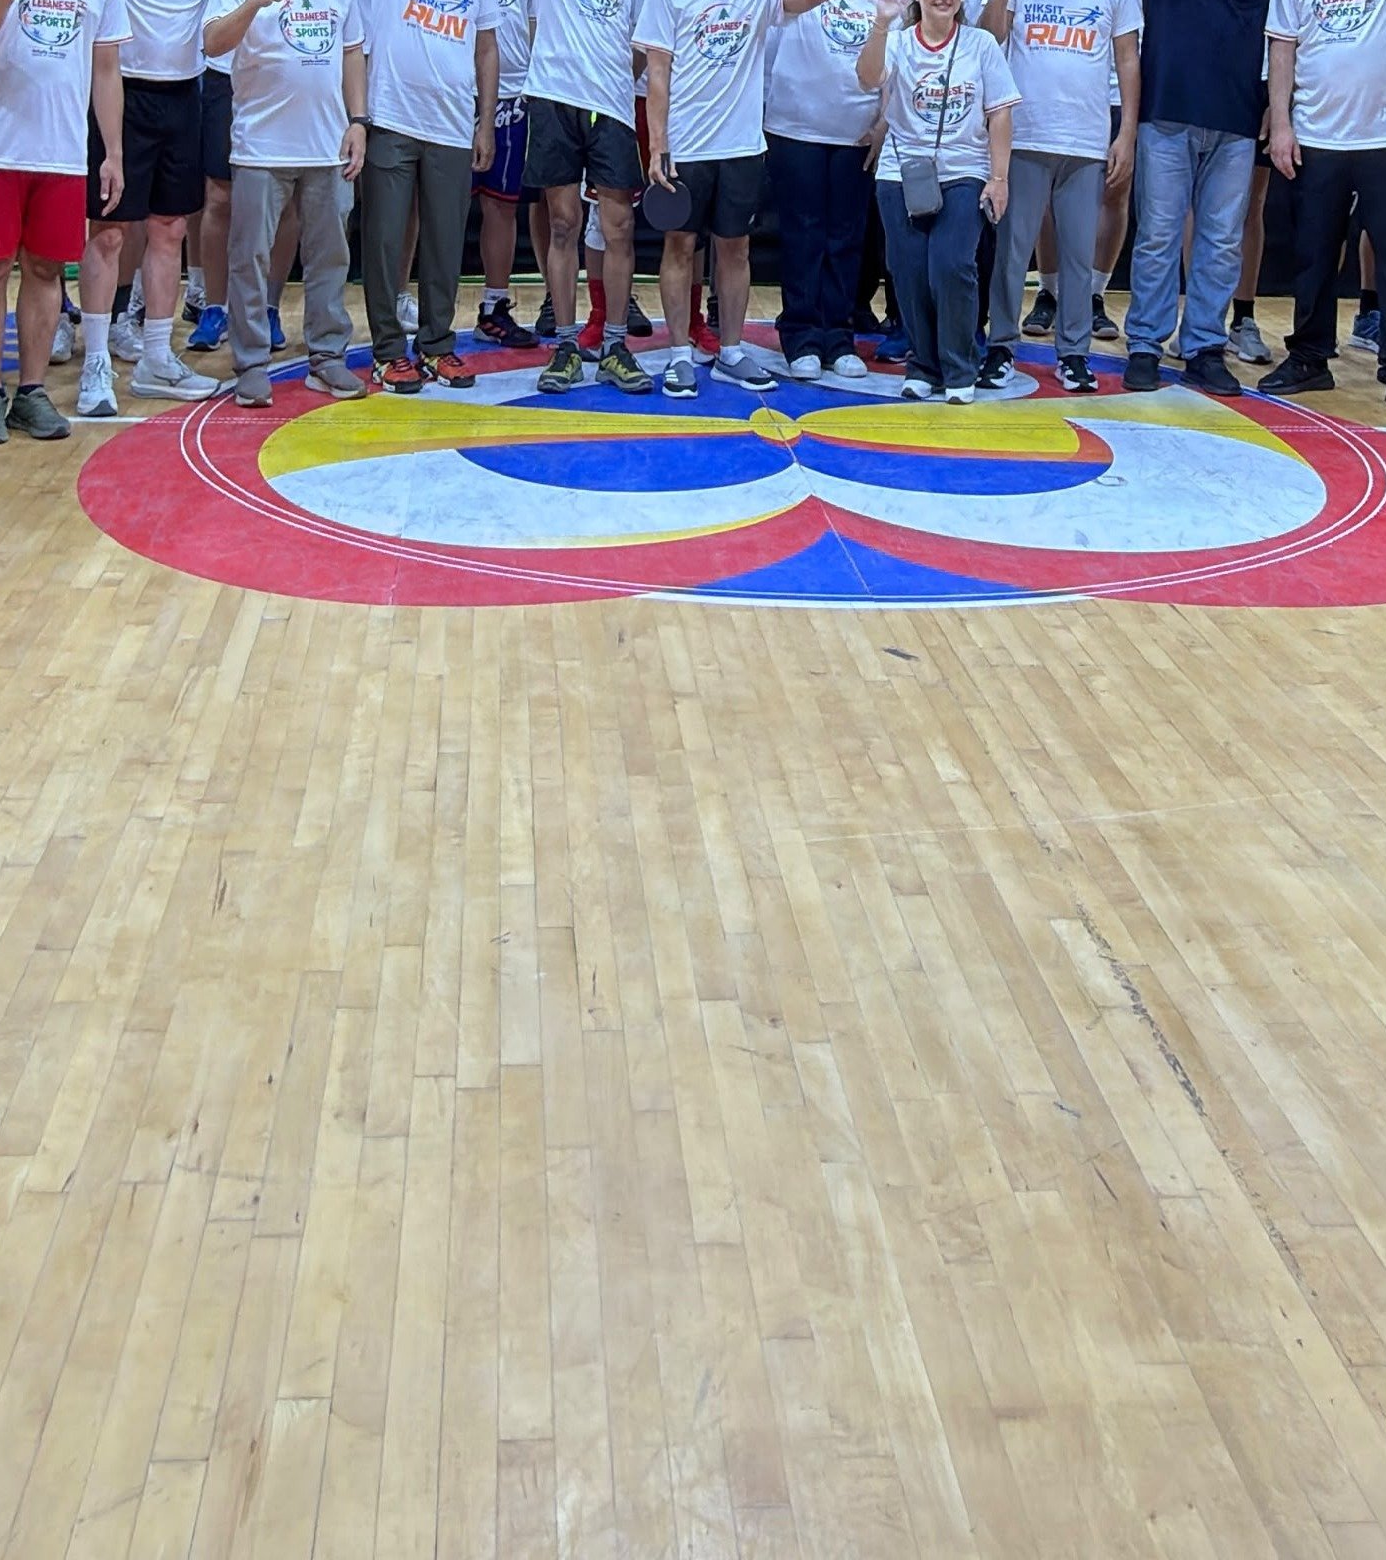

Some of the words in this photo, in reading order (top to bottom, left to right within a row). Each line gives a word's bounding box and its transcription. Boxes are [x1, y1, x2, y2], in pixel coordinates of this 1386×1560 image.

[1024, 4, 1064, 15] VIKSIT
[33, 14, 72, 29] SPORTS
[290, 11, 329, 21] LEBANESE
[402, 0, 469, 40] RUN
[1024, 13, 1075, 26] BHARAT
[295, 26, 330, 38] SPORTS
[1025, 24, 1097, 51] RUN
[925, 85, 964, 97] LEBAESE
[926, 99, 962, 110] SPOTS
